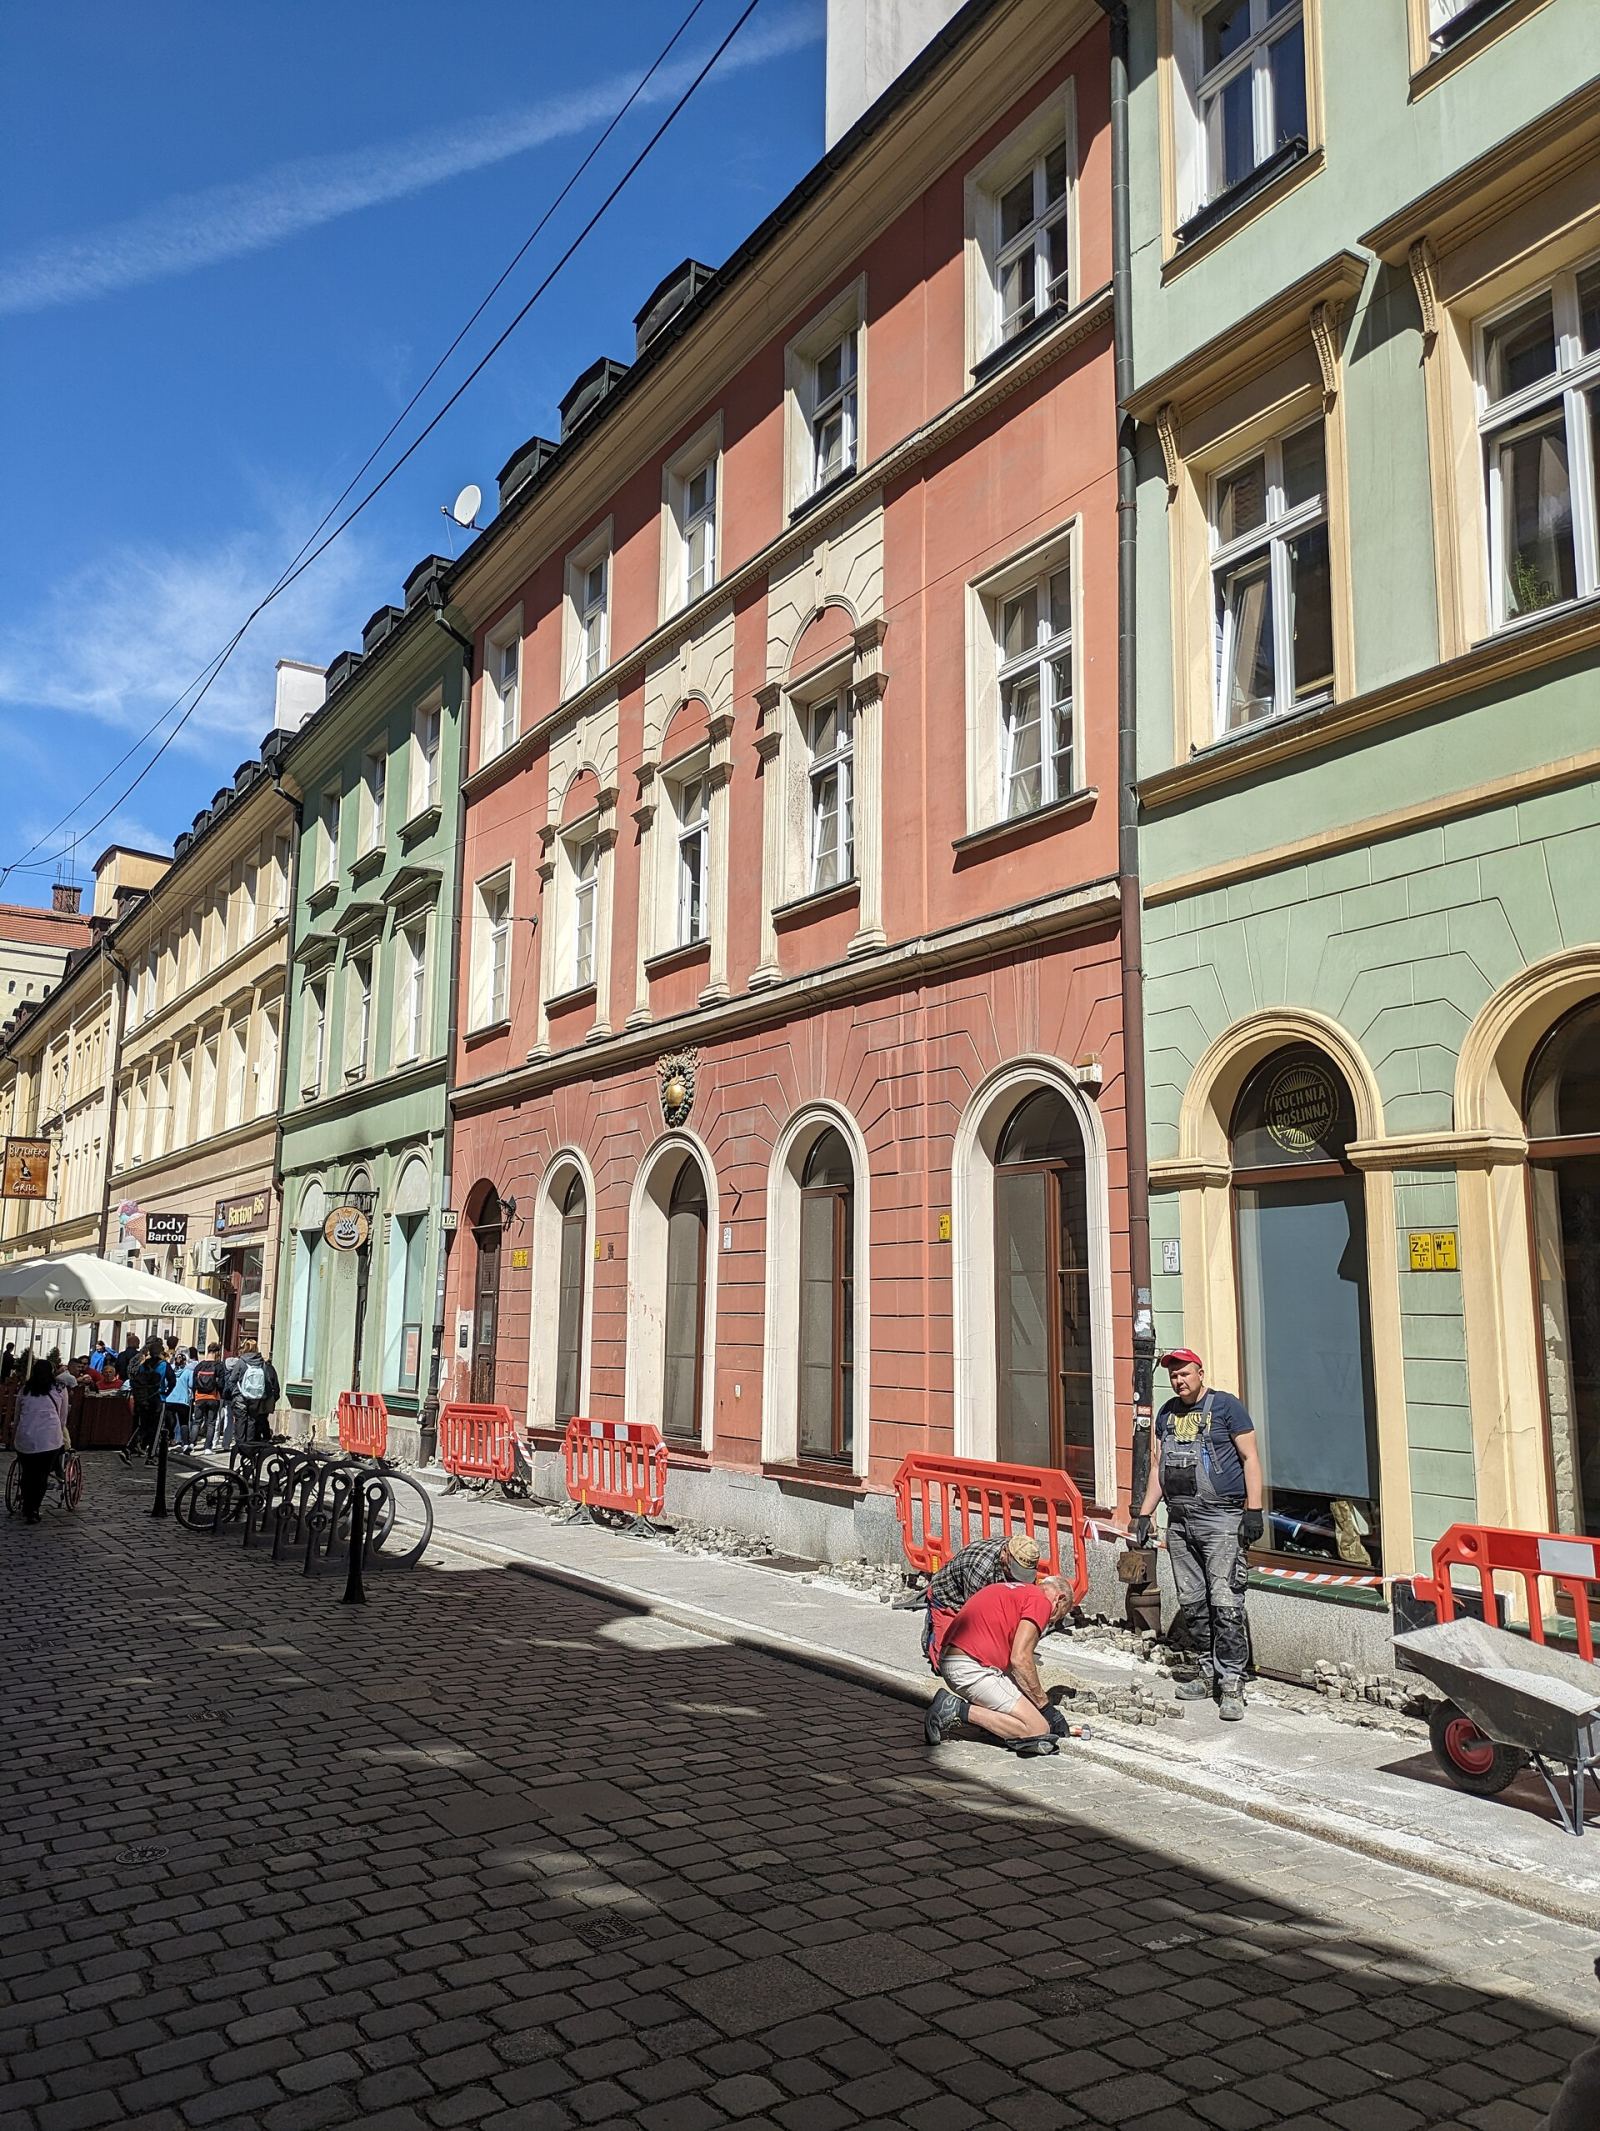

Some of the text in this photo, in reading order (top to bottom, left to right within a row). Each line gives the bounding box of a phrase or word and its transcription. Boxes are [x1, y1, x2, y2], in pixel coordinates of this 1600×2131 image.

[1275, 1085, 1326, 1112] KUCHNIA
[1276, 1101, 1329, 1128] ROŚLINNA
[9, 1143, 48, 1156] BUTCHERY
[12, 1181, 37, 1192] GRILL
[228, 1206, 252, 1227] Barton
[444, 1215, 455, 1223] 1/2
[148, 1218, 186, 1234] Lody
[148, 1233, 185, 1242] Barton
